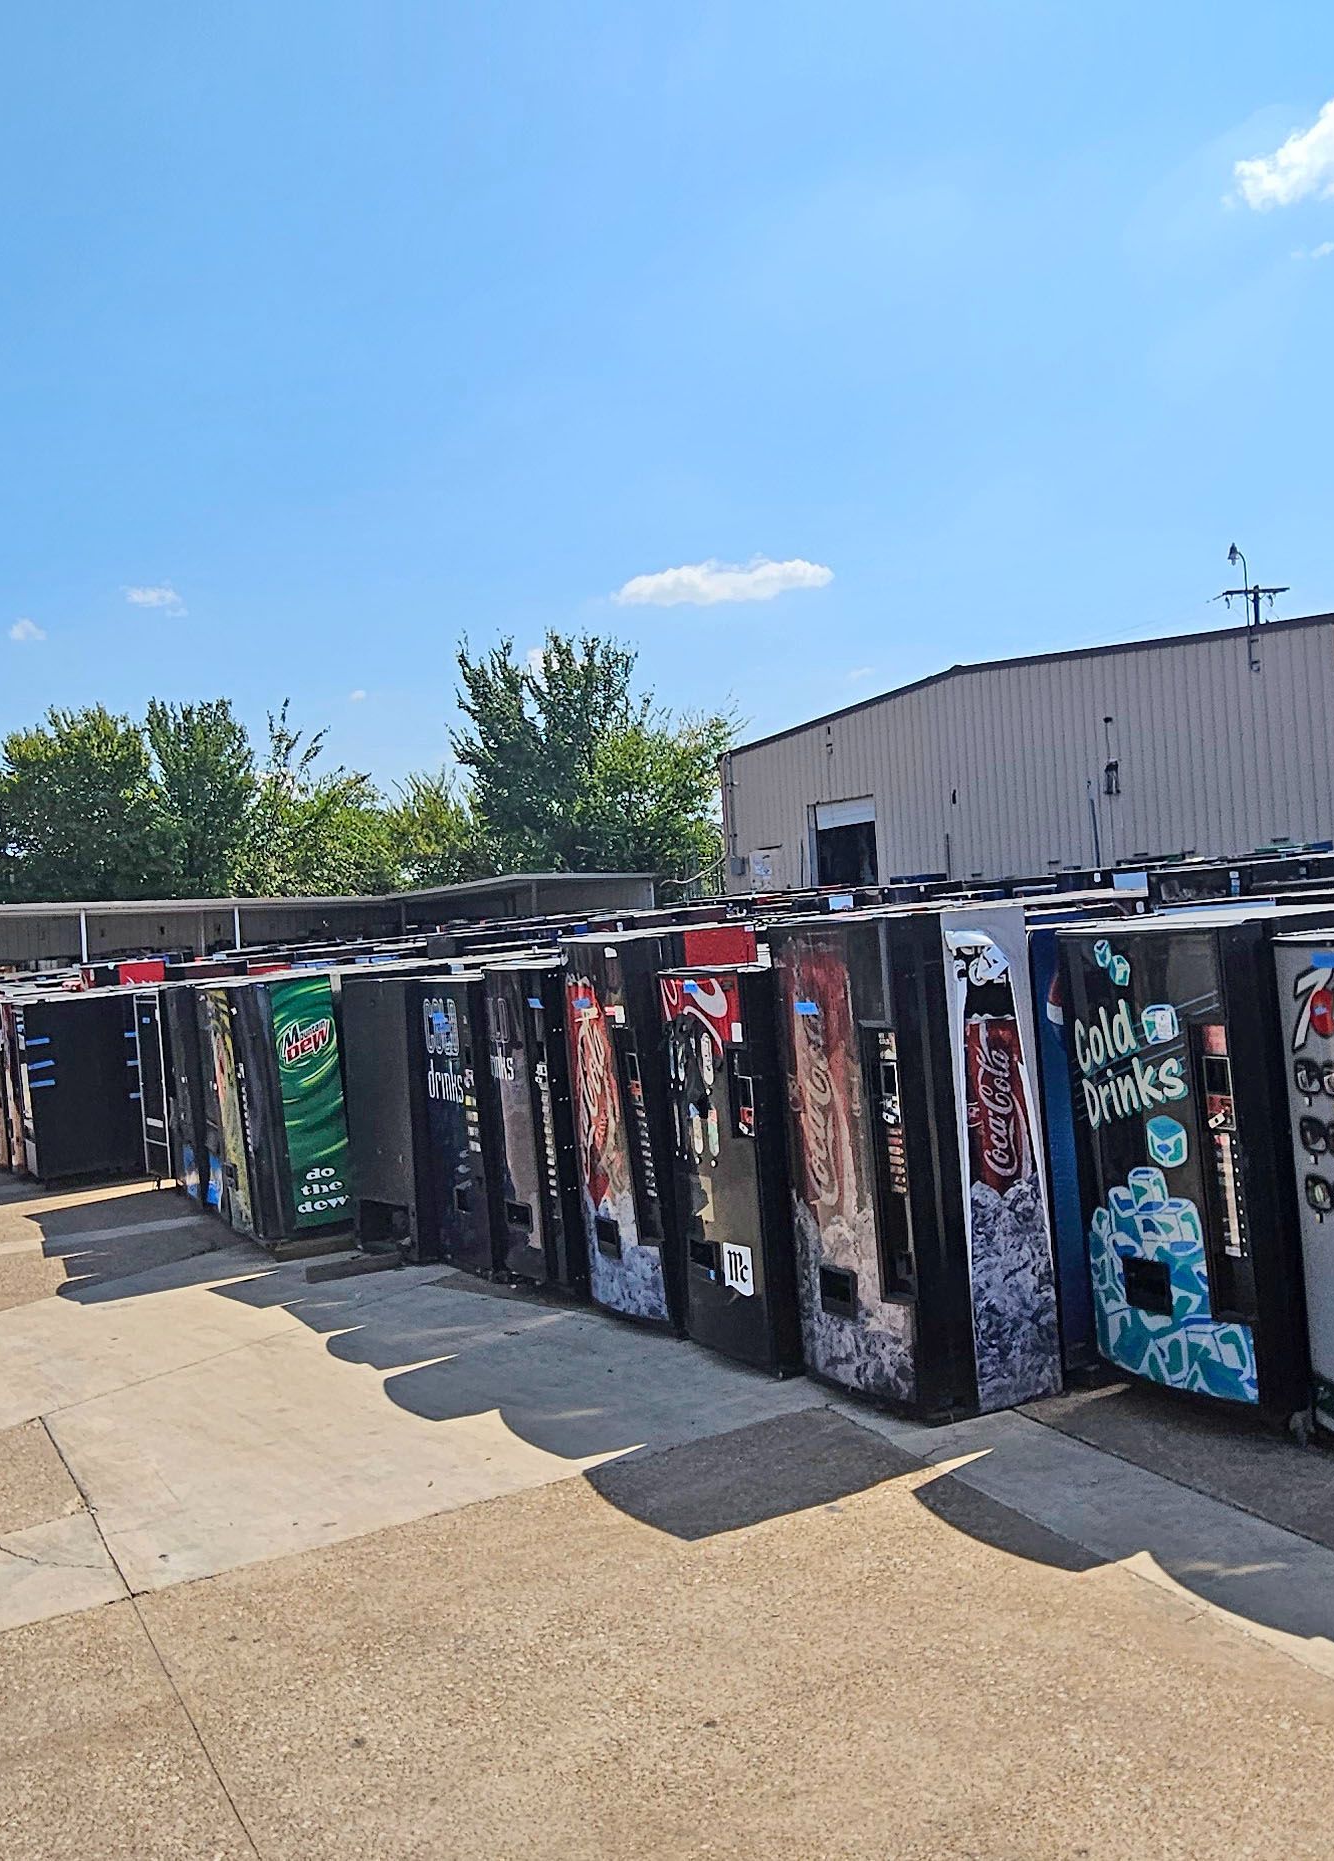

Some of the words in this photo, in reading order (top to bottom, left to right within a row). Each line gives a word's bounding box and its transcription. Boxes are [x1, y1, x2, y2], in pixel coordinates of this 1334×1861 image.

[281, 1019, 328, 1057] Mountain
[1074, 998, 1138, 1074] Cold
[427, 1058, 464, 1103] drinks
[1081, 1056, 1187, 1128] Drinks
[300, 1181, 344, 1195] the
[305, 1167, 336, 1180] do
[297, 1195, 350, 1213] dew
